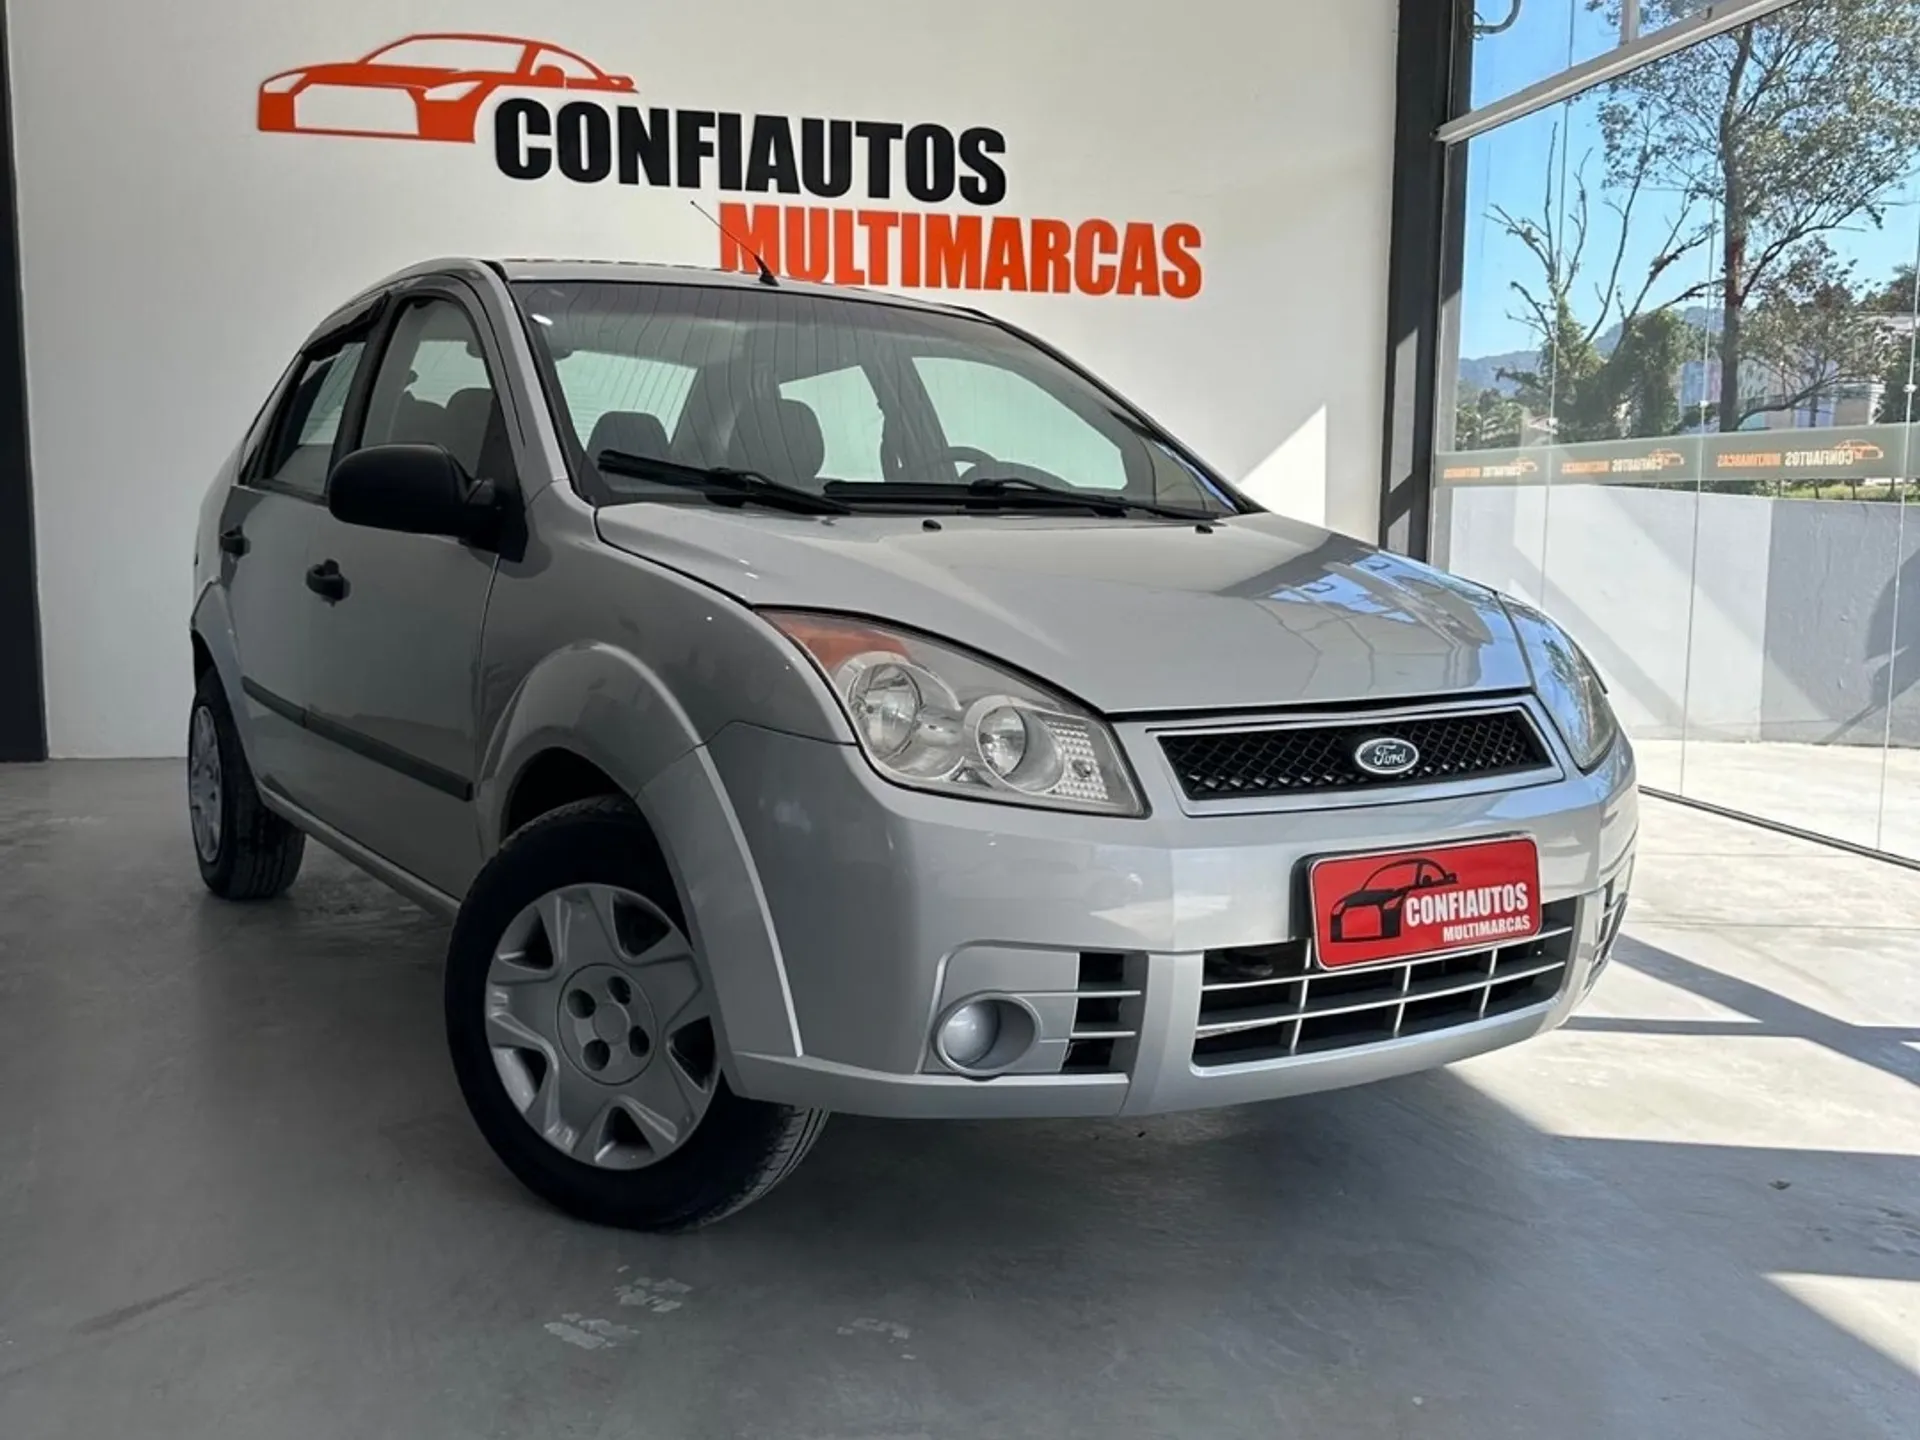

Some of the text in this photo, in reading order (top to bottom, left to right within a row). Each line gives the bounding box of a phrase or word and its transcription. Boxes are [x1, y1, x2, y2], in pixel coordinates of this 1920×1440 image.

[494, 98, 1006, 205] CONFIAUTOS
[720, 202, 1203, 299] MULTIMARCAS
[1374, 745, 1406, 765] Ford
[1406, 882, 1528, 927] CONFIAUTOS
[1443, 914, 1531, 942] MULTIMARCAS
